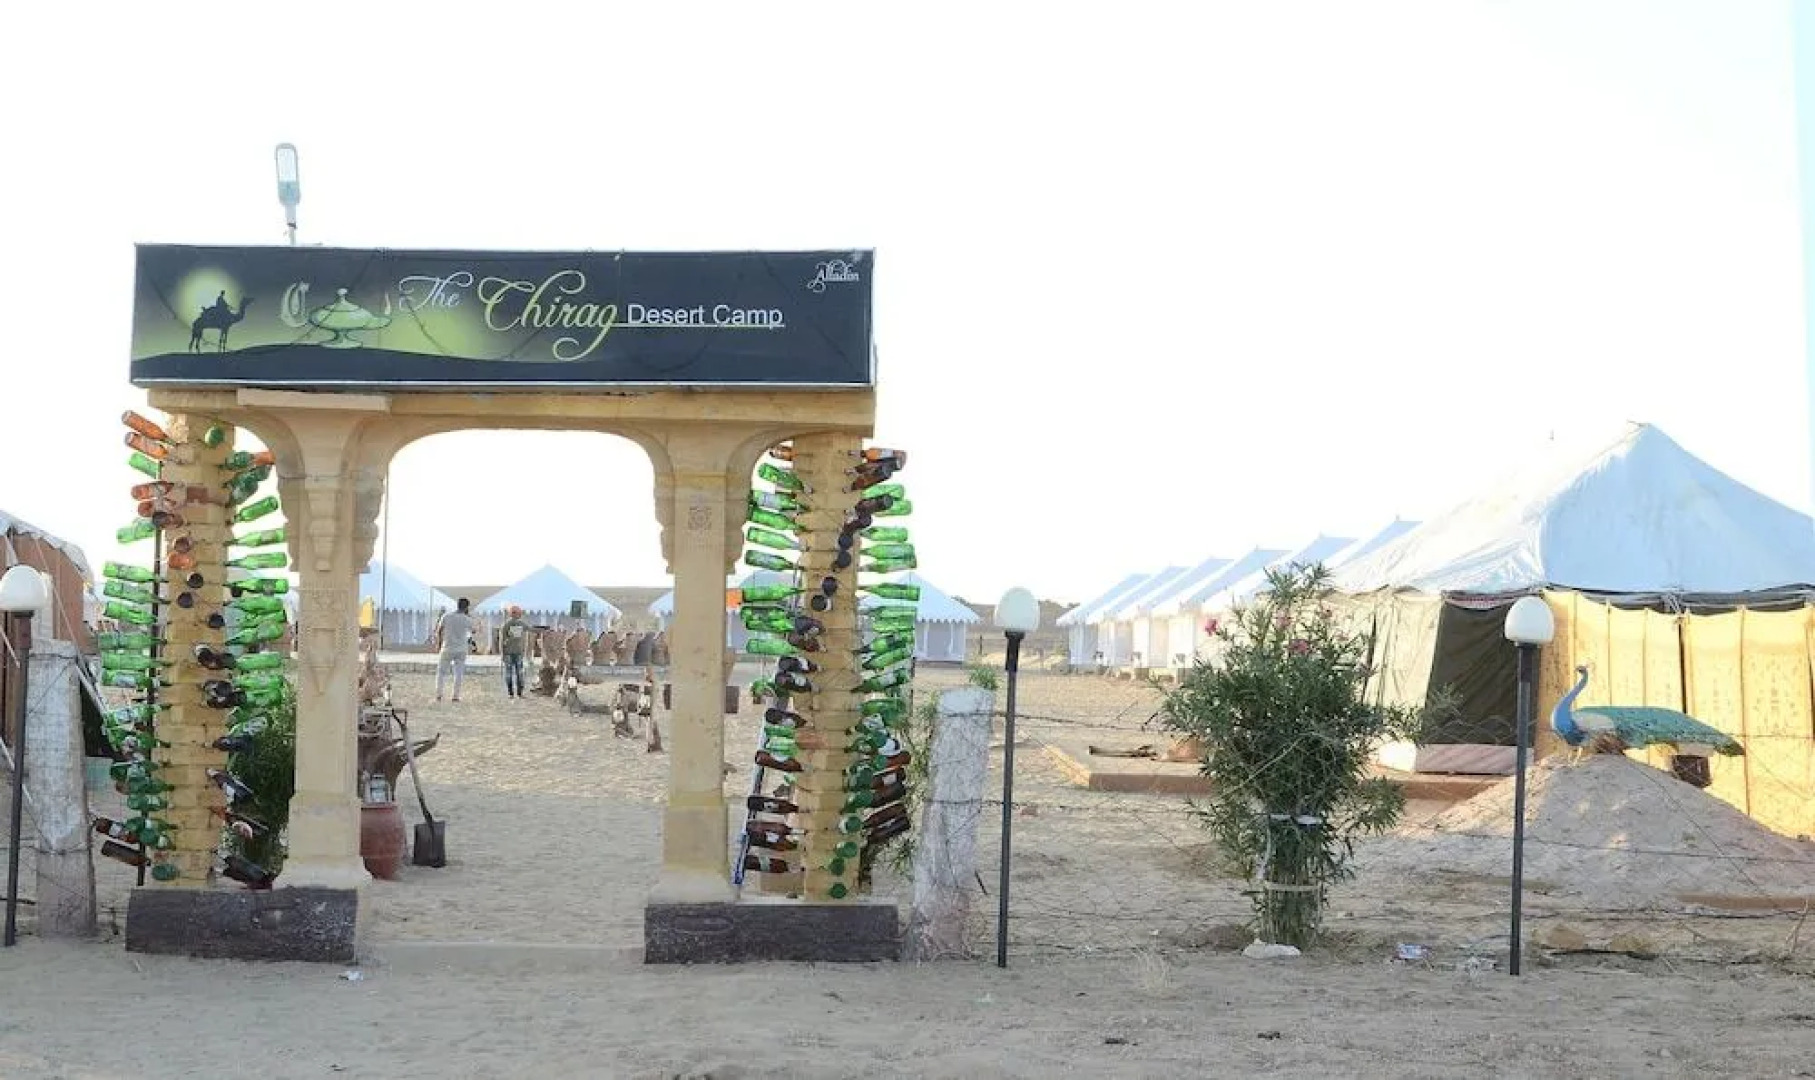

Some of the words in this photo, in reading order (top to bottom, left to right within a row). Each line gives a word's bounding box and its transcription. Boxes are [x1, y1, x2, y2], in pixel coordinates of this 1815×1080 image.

[399, 271, 474, 312] The
[478, 270, 618, 361] Chirag
[627, 304, 705, 325] Desert
[712, 304, 784, 330] Camp
